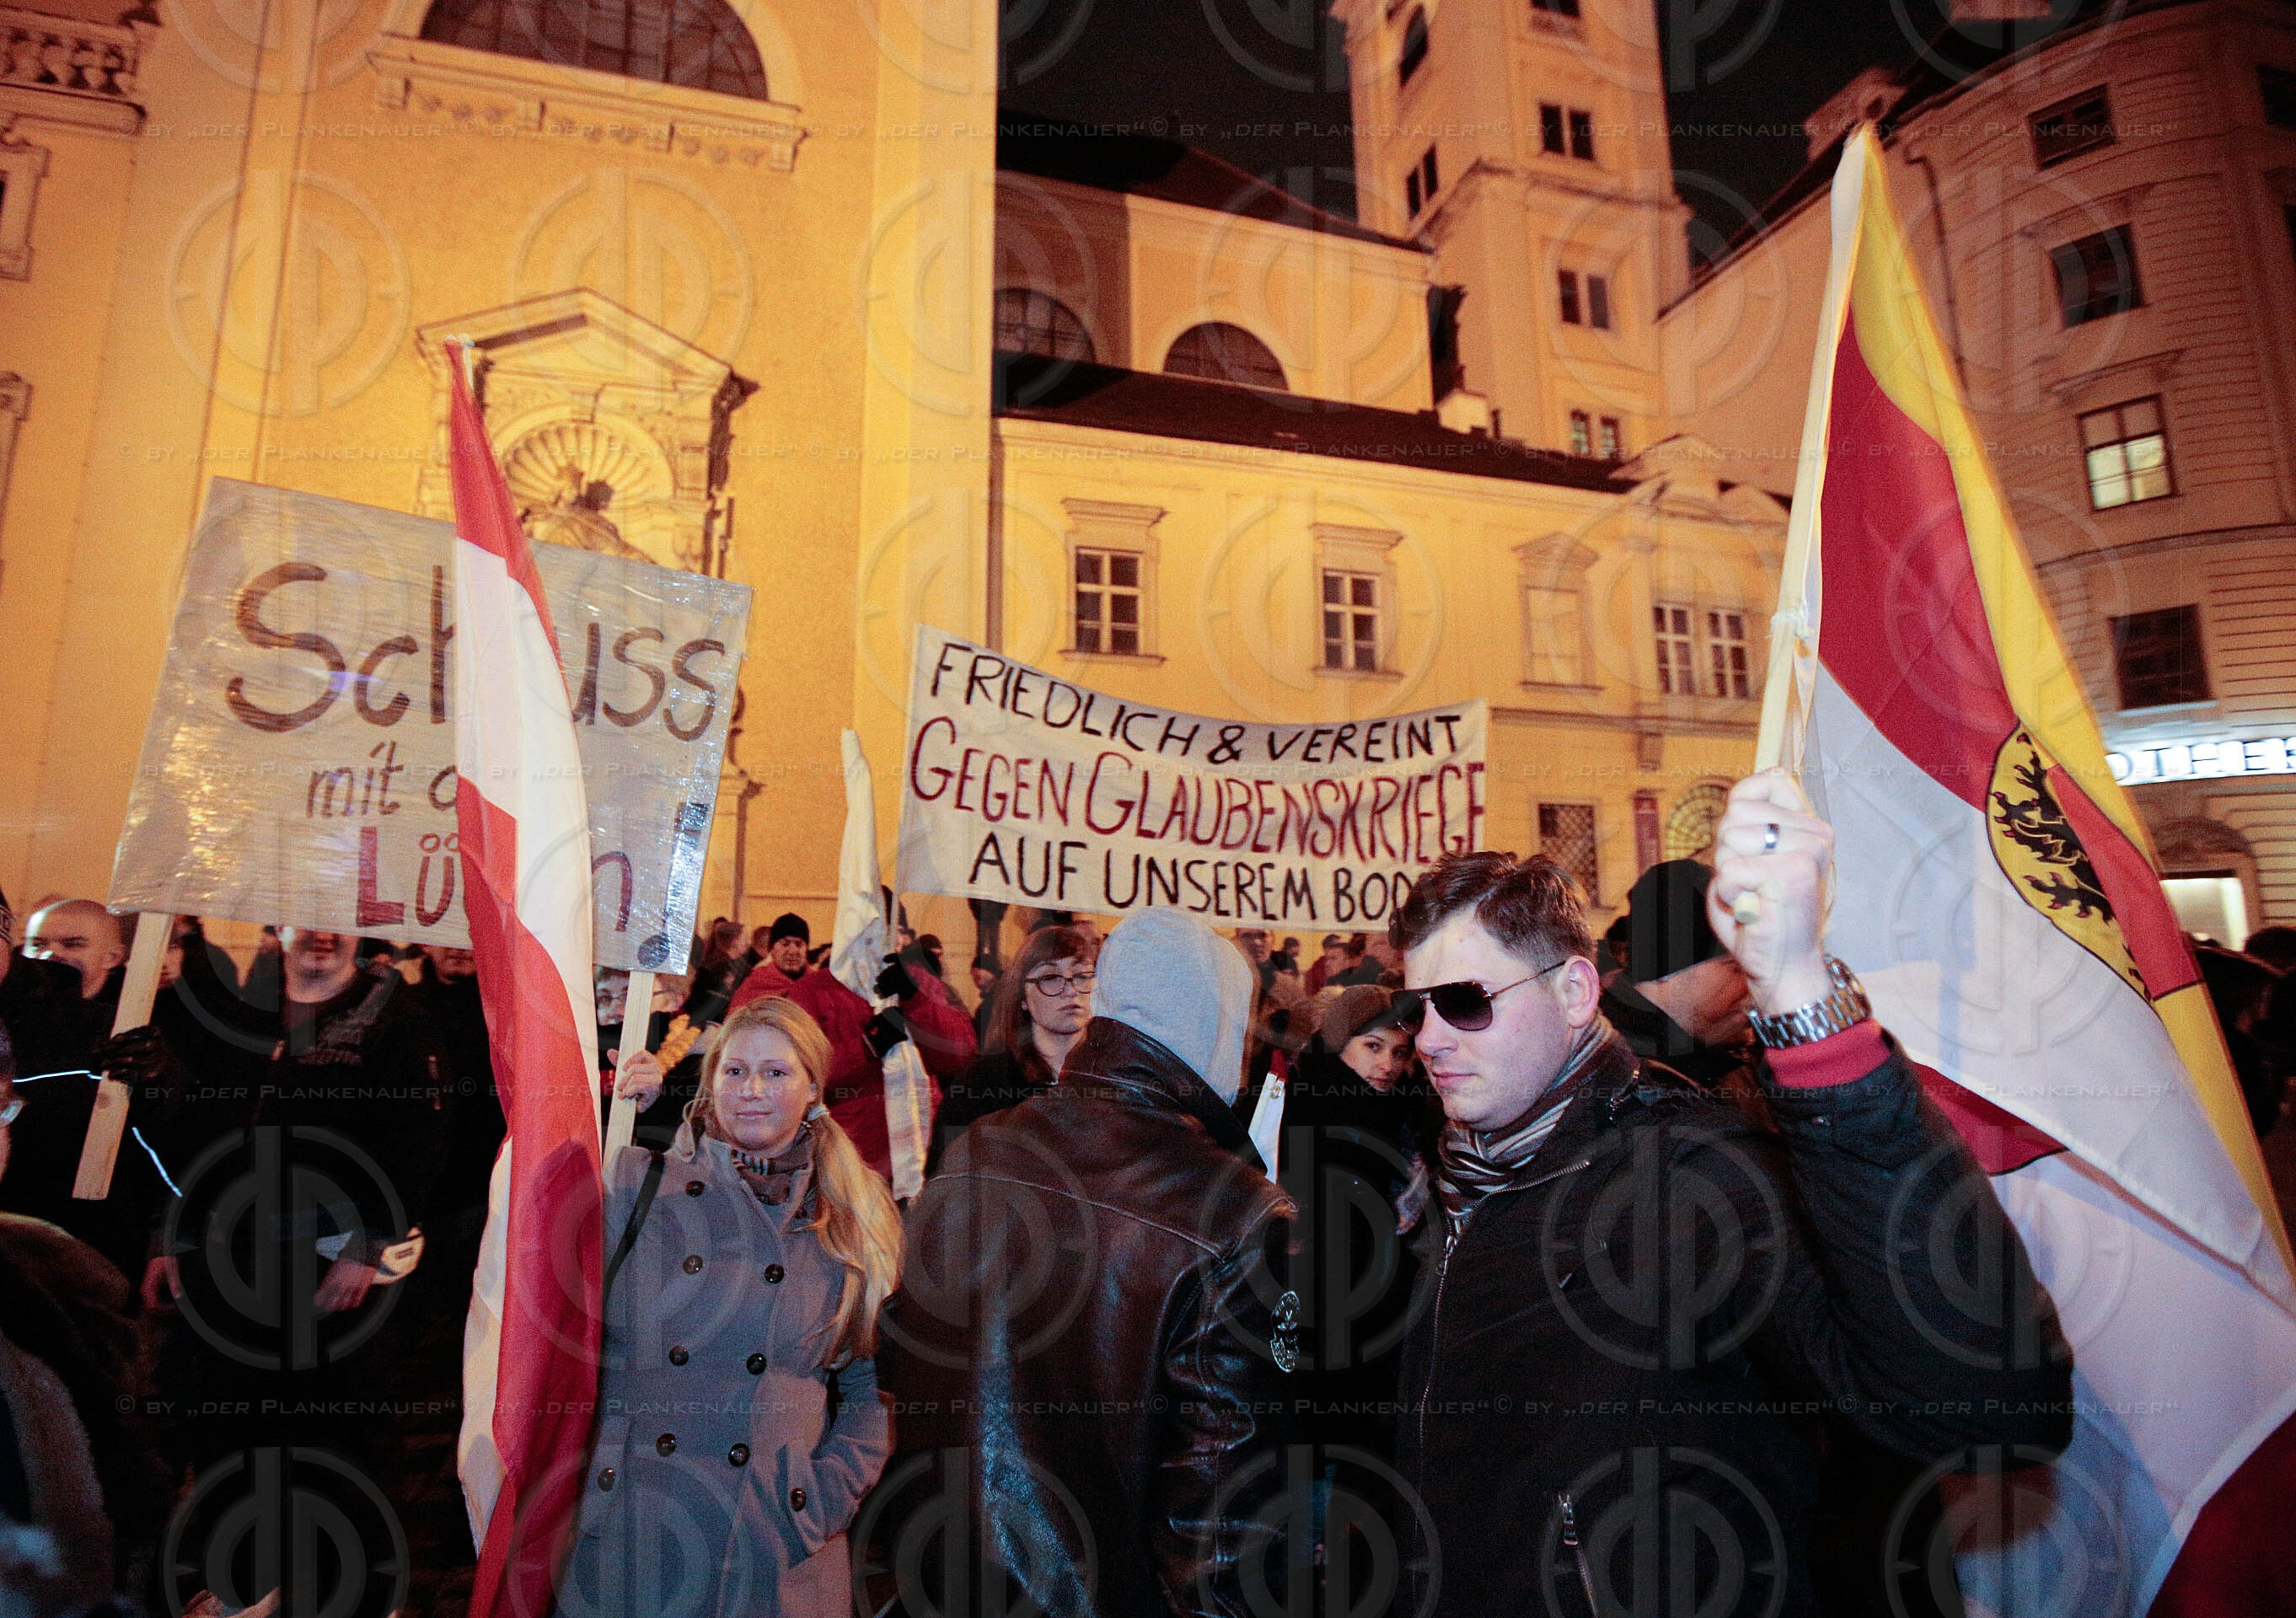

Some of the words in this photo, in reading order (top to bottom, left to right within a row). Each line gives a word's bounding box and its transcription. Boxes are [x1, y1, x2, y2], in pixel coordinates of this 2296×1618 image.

[226, 561, 726, 742] Schuss
[929, 643, 1205, 760] FRIEDLICH
[1208, 724, 1244, 762] &
[1268, 715, 1462, 763] VEREINT
[306, 741, 405, 818] mit
[911, 716, 1072, 827] GEGEN
[969, 831, 1087, 901] AUF
[1104, 848, 1317, 922] UNSEREM
